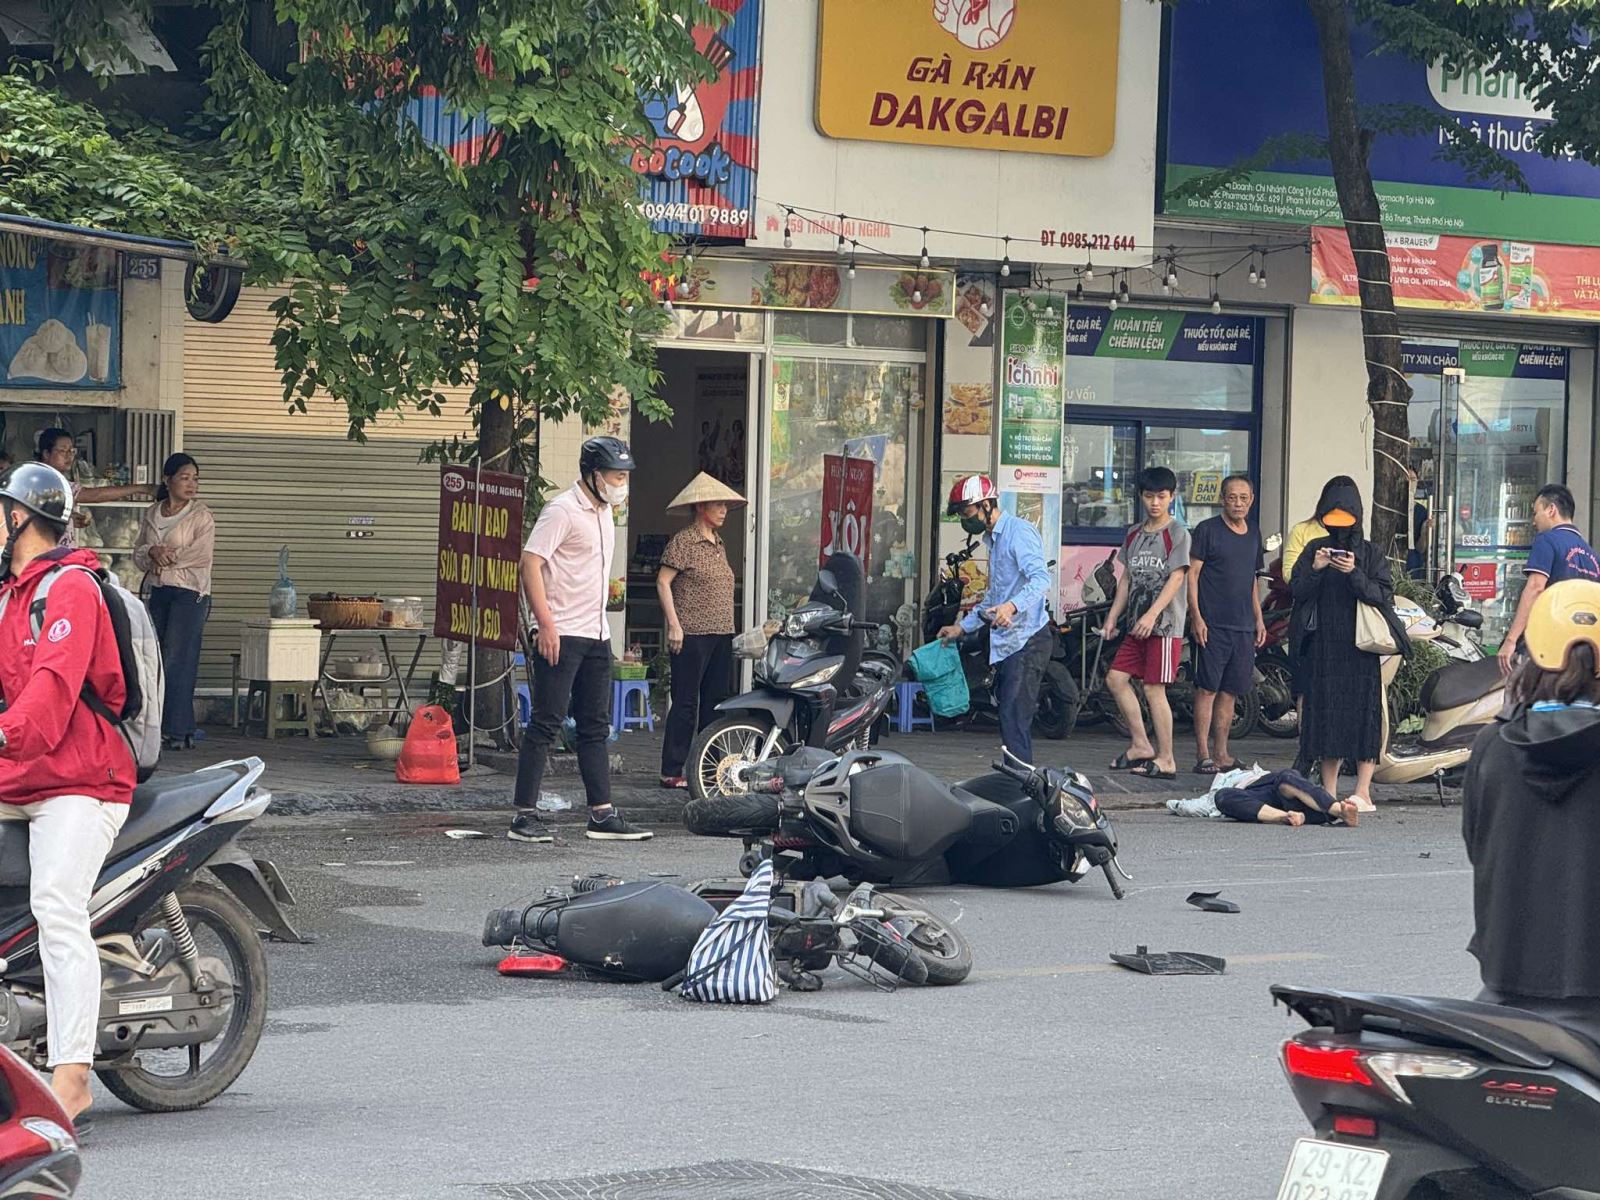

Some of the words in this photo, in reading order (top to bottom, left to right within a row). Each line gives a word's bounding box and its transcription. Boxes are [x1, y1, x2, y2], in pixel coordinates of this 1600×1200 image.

[906, 53, 952, 84] GÀ
[963, 58, 1036, 91] RÁN
[869, 92, 1069, 140] DAKGALBI
[645, 203, 686, 219] 0944
[689, 206, 705, 223] 01
[709, 208, 748, 226] 9889
[1223, 202, 1247, 211] 261-263
[1041, 230, 1056, 247] ĐT
[1060, 232, 1088, 249] 0985
[1091, 234, 1111, 250] 212
[1113, 235, 1135, 251] 644
[1400, 237, 1429, 247] BRAUER
[128, 256, 158, 277] 255
[1342, 274, 1359, 282] ULTR
[1113, 316, 1141, 332] HOÀN
[1183, 323, 1209, 339] THUỐC
[1226, 325, 1239, 339] GIÁ
[1109, 333, 1140, 349] CHÊNH
[1141, 334, 1165, 352] LỆCH
[1401, 353, 1415, 366] ITY
[1416, 354, 1431, 366] XIN
[1432, 352, 1458, 367] CHÀO
[1519, 352, 1544, 366] CHÊNH
[1545, 353, 1565, 369] LỆCH
[445, 475, 462, 489] 255
[466, 481, 485, 492] TRN
[485, 506, 509, 540] BAO
[1130, 556, 1166, 570] EAVEN
[1485, 1095, 1528, 1108] BLACK
